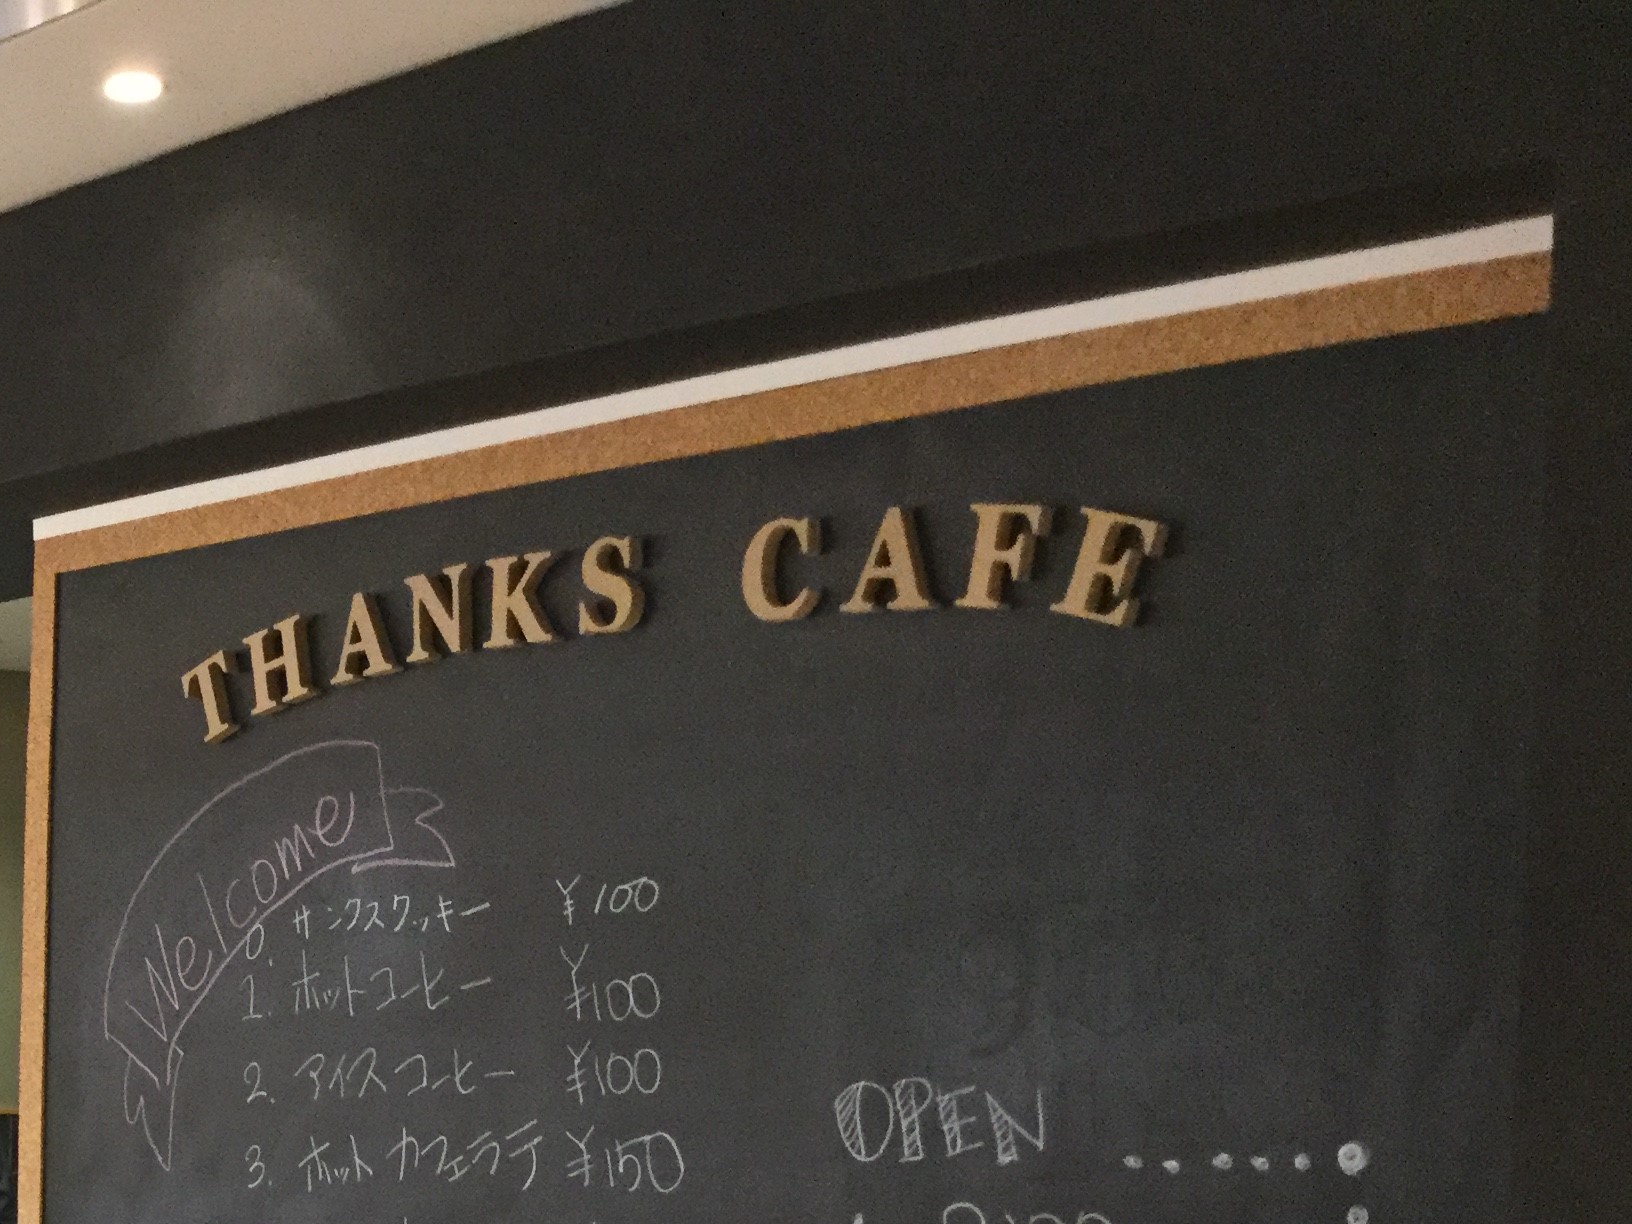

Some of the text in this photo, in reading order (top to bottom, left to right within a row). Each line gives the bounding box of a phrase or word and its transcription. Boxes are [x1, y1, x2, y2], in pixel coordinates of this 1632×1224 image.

[181, 501, 1172, 743] THANKS CAFE
[125, 790, 354, 1041] Welcome
[564, 943, 661, 1021] ¥100
[244, 1062, 275, 1105] 2.
[567, 1040, 661, 1104] ¥100
[245, 1145, 273, 1189] 3.
[566, 1125, 685, 1193] ¥150
[834, 1077, 1044, 1166] OPEN
